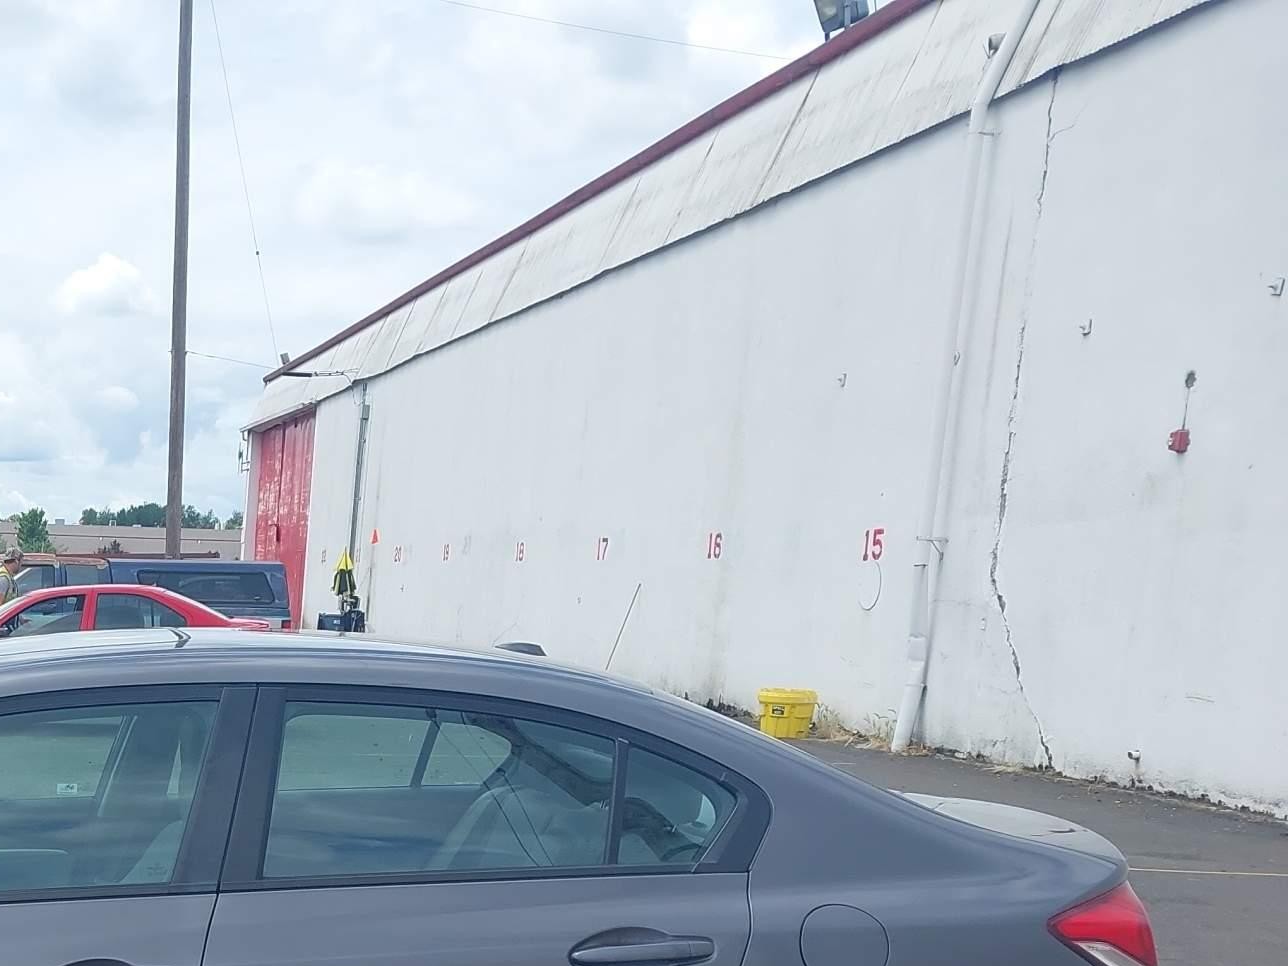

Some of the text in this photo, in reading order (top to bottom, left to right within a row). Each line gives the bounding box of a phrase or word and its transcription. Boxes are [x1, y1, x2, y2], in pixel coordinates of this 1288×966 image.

[394, 546, 402, 563] 20
[442, 543, 450, 561] 19
[515, 542, 525, 562] 18
[596, 537, 609, 560] 17
[707, 532, 722, 559] 16
[862, 528, 885, 561] 15
